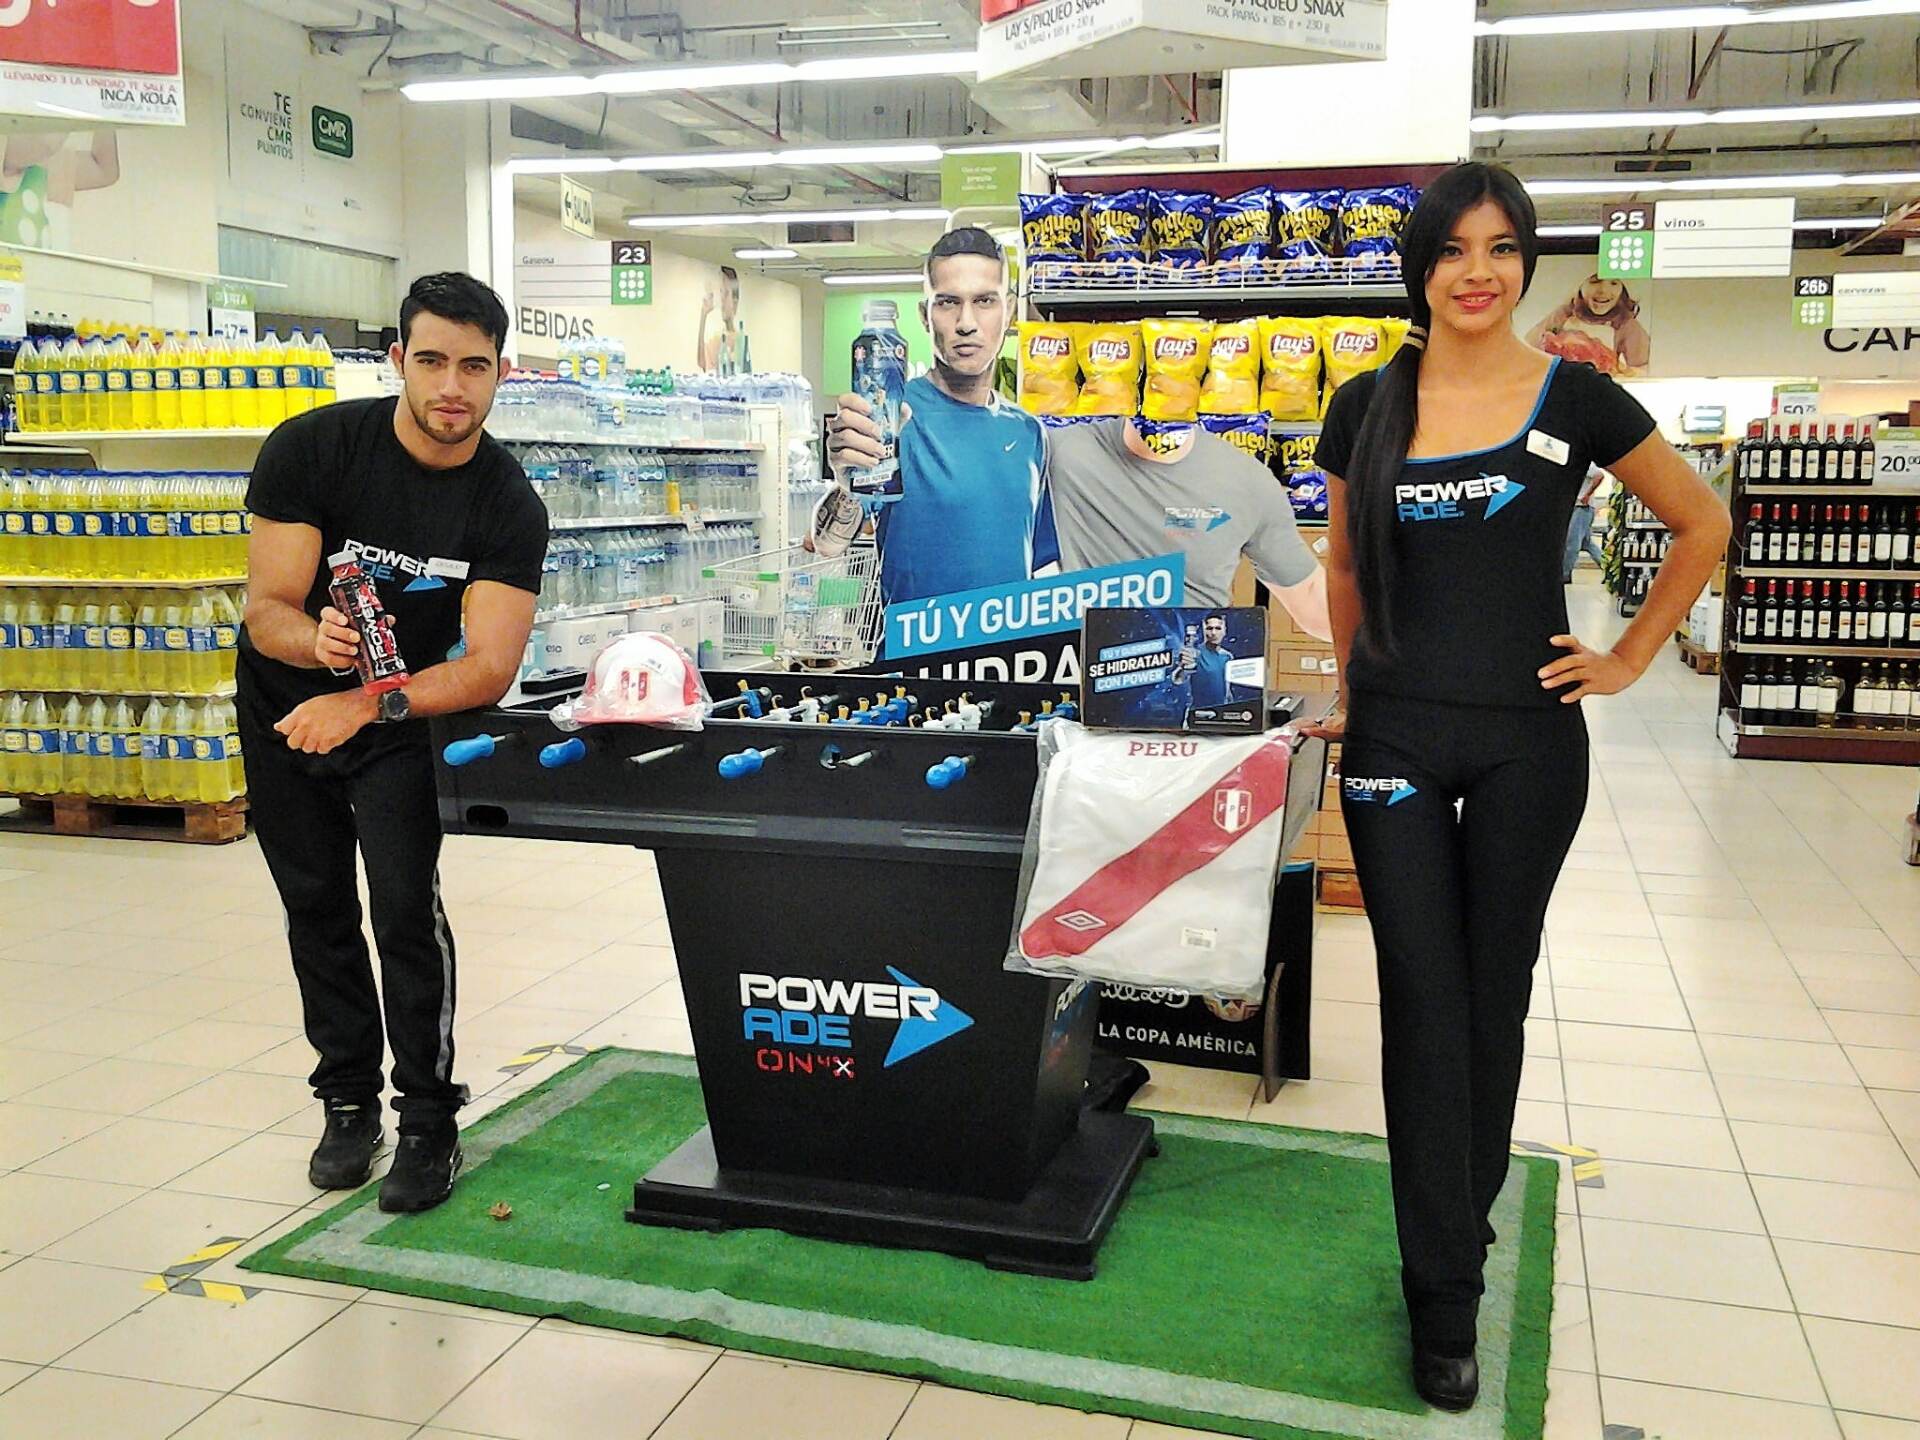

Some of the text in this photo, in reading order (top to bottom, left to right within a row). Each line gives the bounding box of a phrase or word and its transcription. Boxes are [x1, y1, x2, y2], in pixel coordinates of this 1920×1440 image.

[86, 78, 126, 89] UNIDAD
[100, 88, 177, 106] INCA KOLA
[274, 92, 292, 115] TE
[240, 103, 292, 130] CONVIENE
[268, 126, 292, 145] CMR
[318, 114, 347, 141] CMR
[257, 139, 294, 160] PUNTOS
[1609, 210, 1644, 231] 25
[1664, 218, 1705, 228] vinos
[522, 255, 554, 265] Gaseosa
[618, 246, 646, 264] 23
[1800, 280, 1828, 295] 26b
[515, 305, 594, 340] EBIDAS
[1394, 474, 1509, 504] POWER
[1398, 500, 1459, 522] ADE
[343, 539, 432, 580] POWER
[358, 560, 391, 580] DE
[896, 568, 1172, 648] TÚ Y GUERRERO
[1089, 652, 1170, 678] SE HIDRATAN
[1097, 670, 1163, 691] CON POWER
[1128, 740, 1198, 758] PERU
[1344, 777, 1408, 792] POWER
[739, 972, 941, 1022] POWER
[743, 1007, 852, 1048] ADE
[1098, 1022, 1257, 1058] LA COPA AMÉRICA
